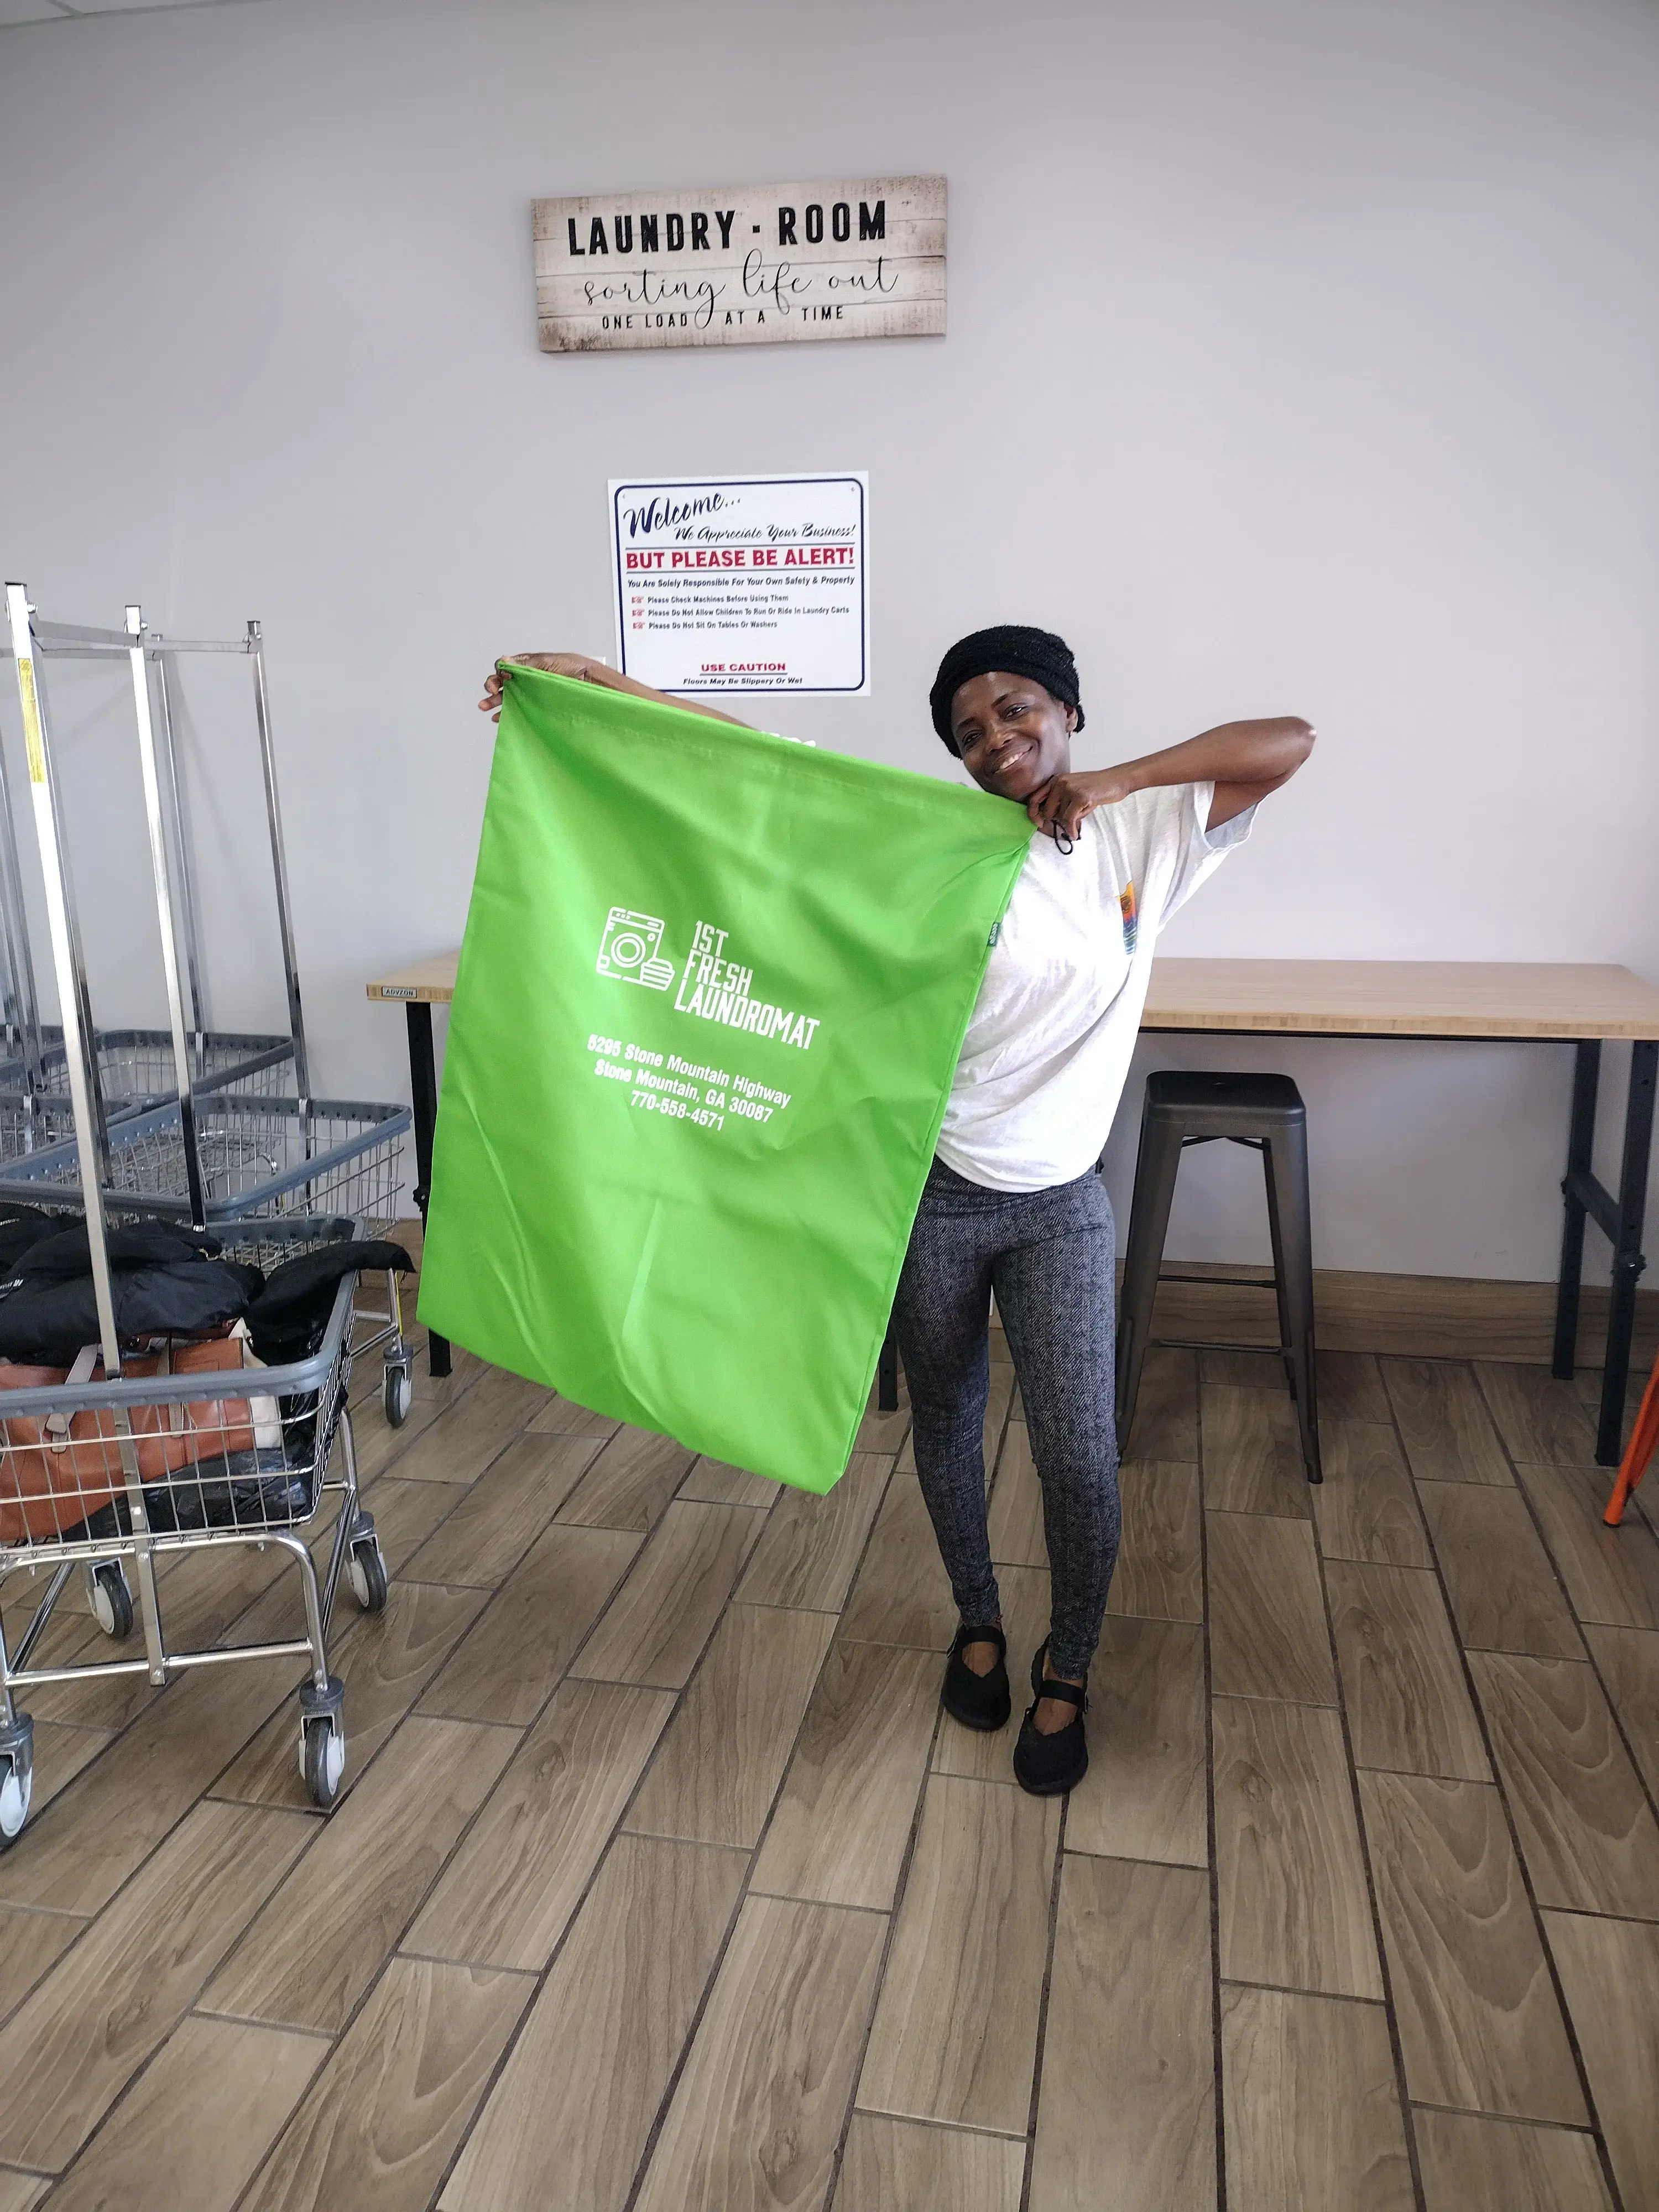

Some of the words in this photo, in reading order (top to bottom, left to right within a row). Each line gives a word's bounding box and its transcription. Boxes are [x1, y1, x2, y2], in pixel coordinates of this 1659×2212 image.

[567, 209, 735, 256] LAUNDRY
[778, 200, 886, 246] ROOM
[583, 269, 727, 329] sorting
[741, 248, 815, 315] life
[828, 255, 899, 293] out
[602, 315, 634, 330] ONE
[645, 313, 688, 328] LOAD
[725, 311, 745, 325] AT
[757, 310, 766, 324] A
[801, 305, 844, 321] TIME
[674, 525, 695, 540] We
[697, 525, 763, 543] Appreciate
[766, 524, 799, 542] Your
[802, 522, 857, 538] Business!
[627, 551, 665, 569] BUT
[671, 549, 746, 568] PLEASE
[753, 549, 778, 566] BE
[784, 546, 854, 566] ALERT!
[628, 579, 641, 588] You
[642, 579, 655, 588] Are
[658, 578, 681, 588] Solely
[682, 578, 729, 588] Responsible
[732, 577, 745, 587] For
[747, 577, 764, 586] Your
[765, 577, 783, 586] Own
[785, 576, 811, 586] Safety
[812, 576, 818, 585] &
[821, 576, 855, 586] Property
[671, 596, 691, 604] Check
[693, 595, 724, 603] Machines
[727, 594, 748, 603] Before
[750, 594, 769, 603] Using
[770, 594, 789, 602] Them
[671, 608, 680, 617] Do
[682, 608, 694, 617] Not
[695, 608, 714, 616] Allow
[716, 607, 743, 616] Children
[778, 607, 792, 615] Ride
[802, 606, 830, 615] Laundry
[649, 622, 671, 630] Please
[682, 621, 694, 629] Not
[696, 621, 705, 629] Sit
[718, 620, 739, 629] Tables
[750, 620, 778, 628] Washers
[701, 663, 726, 672] USE
[729, 662, 786, 672] CAUTION
[740, 676, 774, 685] Slippery
[691, 920, 729, 957] 1ST
[682, 948, 754, 997] FRESH
[674, 977, 821, 1050] LAUNDROMAT
[624, 1043, 664, 1067] Stone
[666, 1053, 731, 1088] Mountain
[732, 1074, 792, 1109] Highway
[594, 1058, 633, 1083] Stone
[635, 1068, 701, 1104] Mountain,
[705, 1088, 726, 1109] GA
[728, 1095, 774, 1124] 30087
[630, 1089, 725, 1131] 770-558-4571
